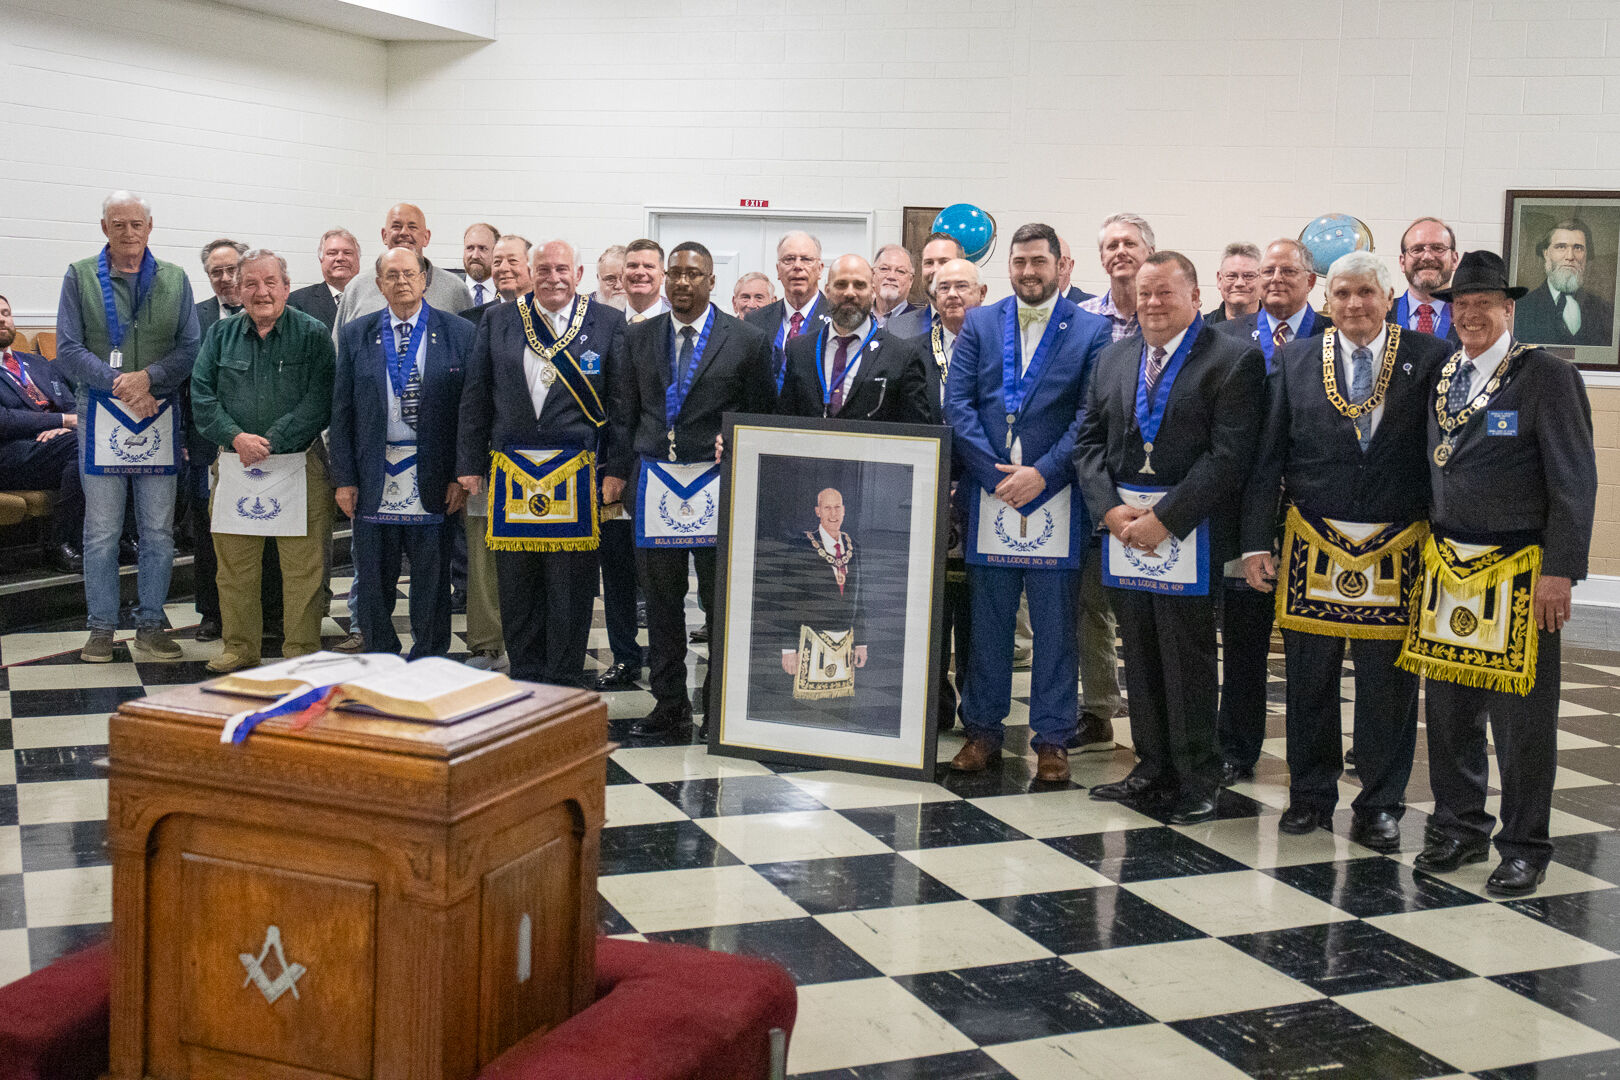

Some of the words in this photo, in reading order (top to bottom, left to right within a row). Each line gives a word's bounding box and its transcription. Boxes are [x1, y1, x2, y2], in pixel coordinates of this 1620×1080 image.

[745, 199, 764, 207] EXIT
[987, 555, 1005, 563] BULA
[1007, 556, 1030, 564] LODGE
[1119, 578, 1136, 586] BULA
[1138, 580, 1158, 589] LODGE
